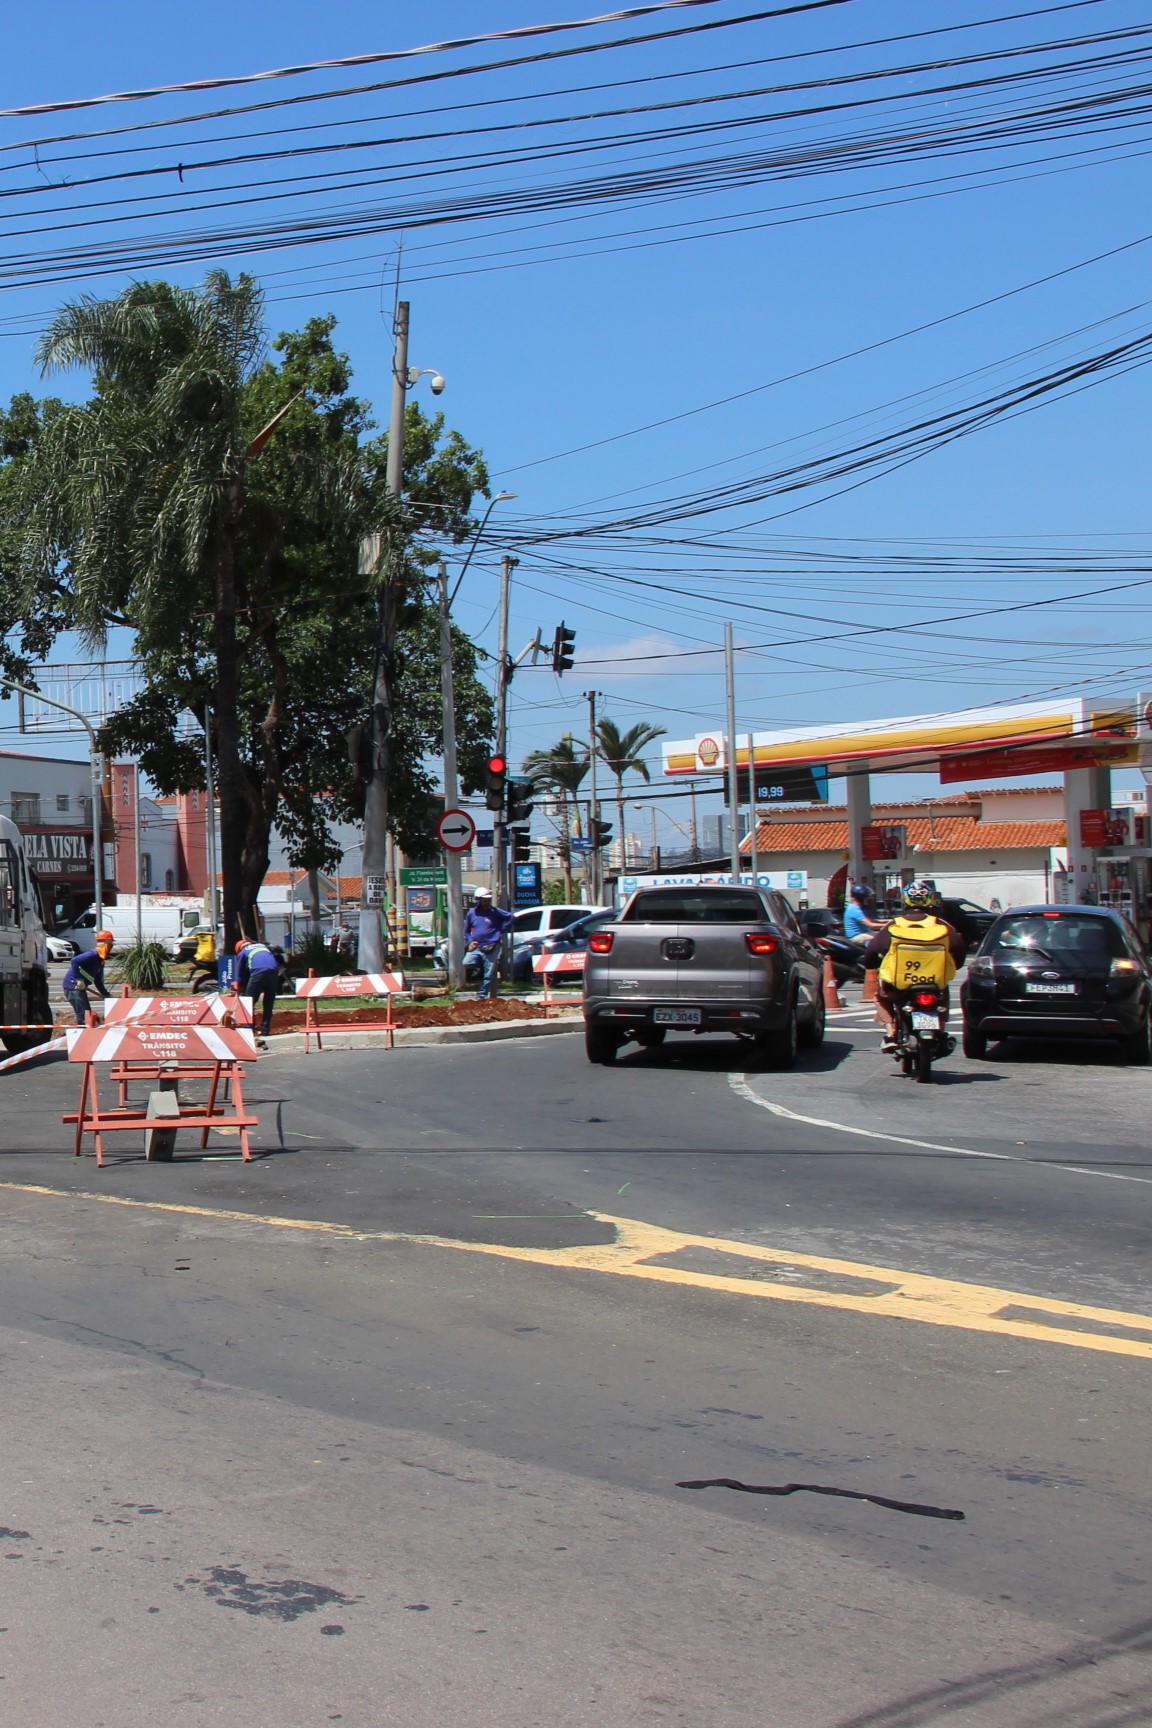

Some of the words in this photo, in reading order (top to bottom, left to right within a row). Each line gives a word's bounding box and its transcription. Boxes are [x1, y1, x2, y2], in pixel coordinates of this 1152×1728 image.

[21, 835, 48, 858] ELA
[51, 836, 87, 859] VISTA
[37, 861, 62, 873] CARNES
[905, 961, 921, 971] 99
[904, 973, 936, 984] Food
[149, 1032, 188, 1040] EMDEC
[142, 1042, 186, 1050] TRÂNSITO
